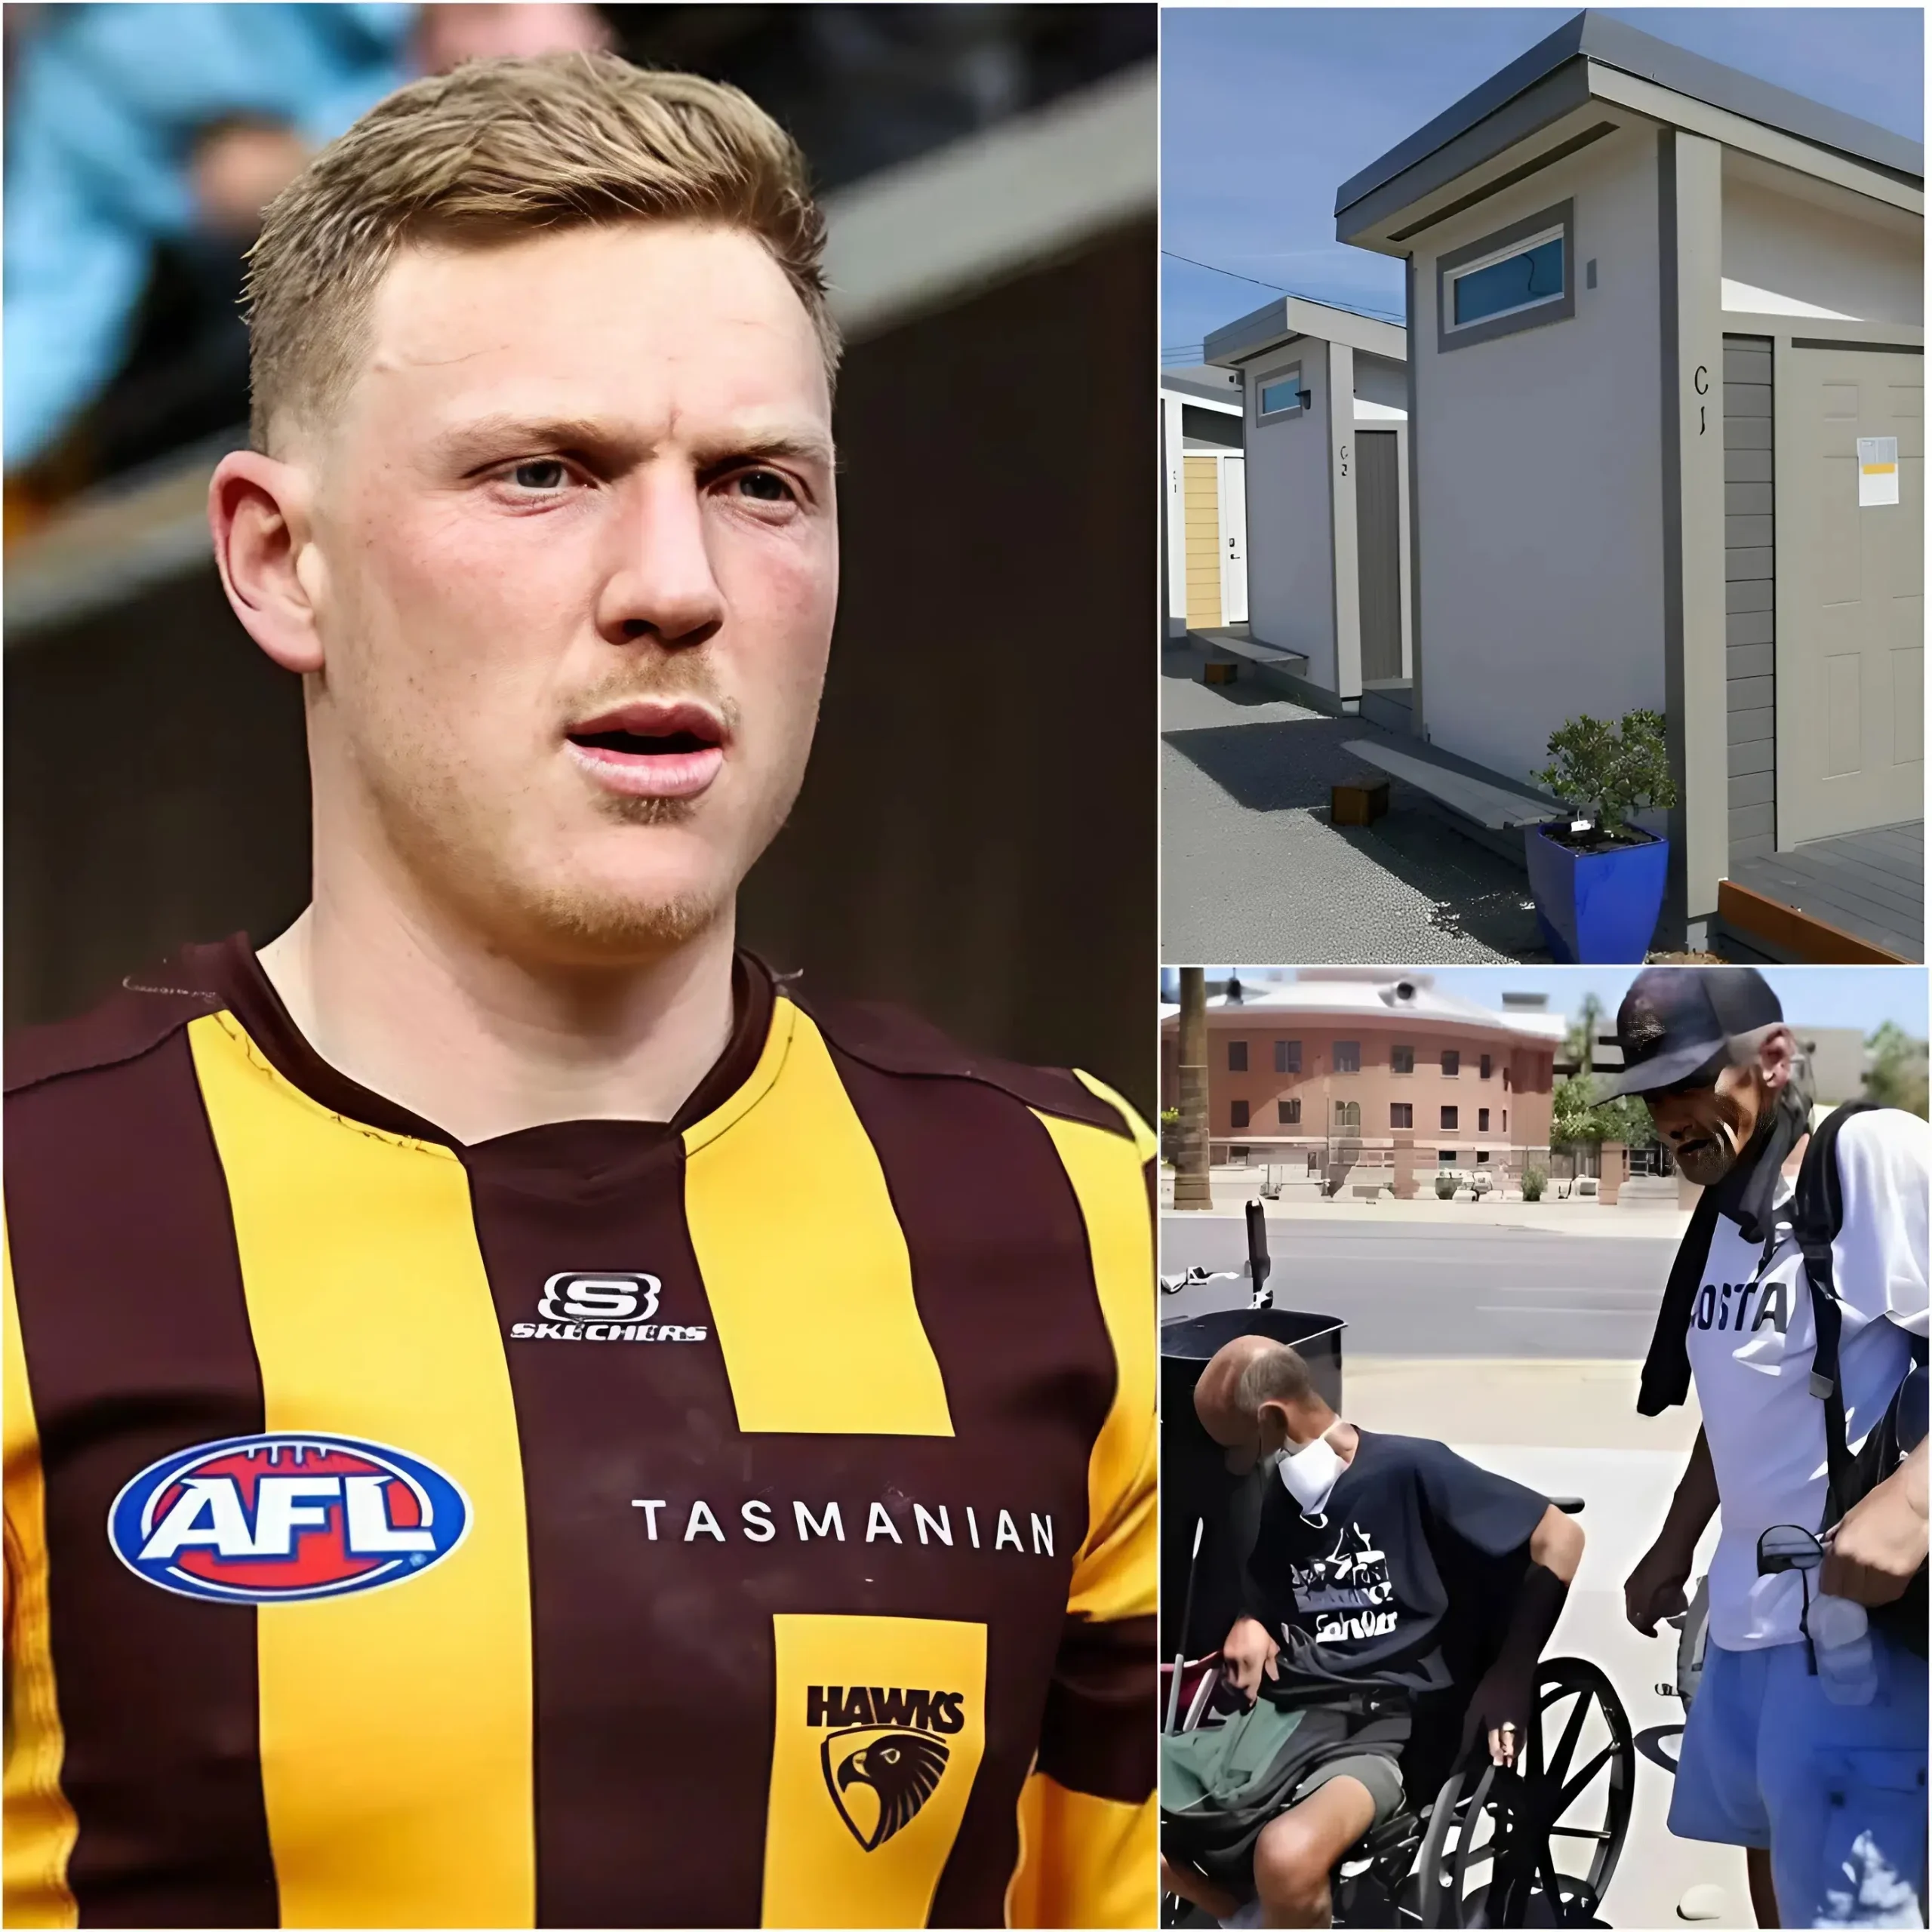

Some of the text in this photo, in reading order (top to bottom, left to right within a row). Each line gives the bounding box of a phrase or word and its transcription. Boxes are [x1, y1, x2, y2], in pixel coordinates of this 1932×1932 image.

[510, 1323, 708, 1341] SKECHERS
[1690, 1281, 1787, 1334] OSTA
[137, 1475, 437, 1560] AFL
[631, 1500, 1054, 1557] TASMANIAN
[807, 1685, 964, 1734] HAWKS
